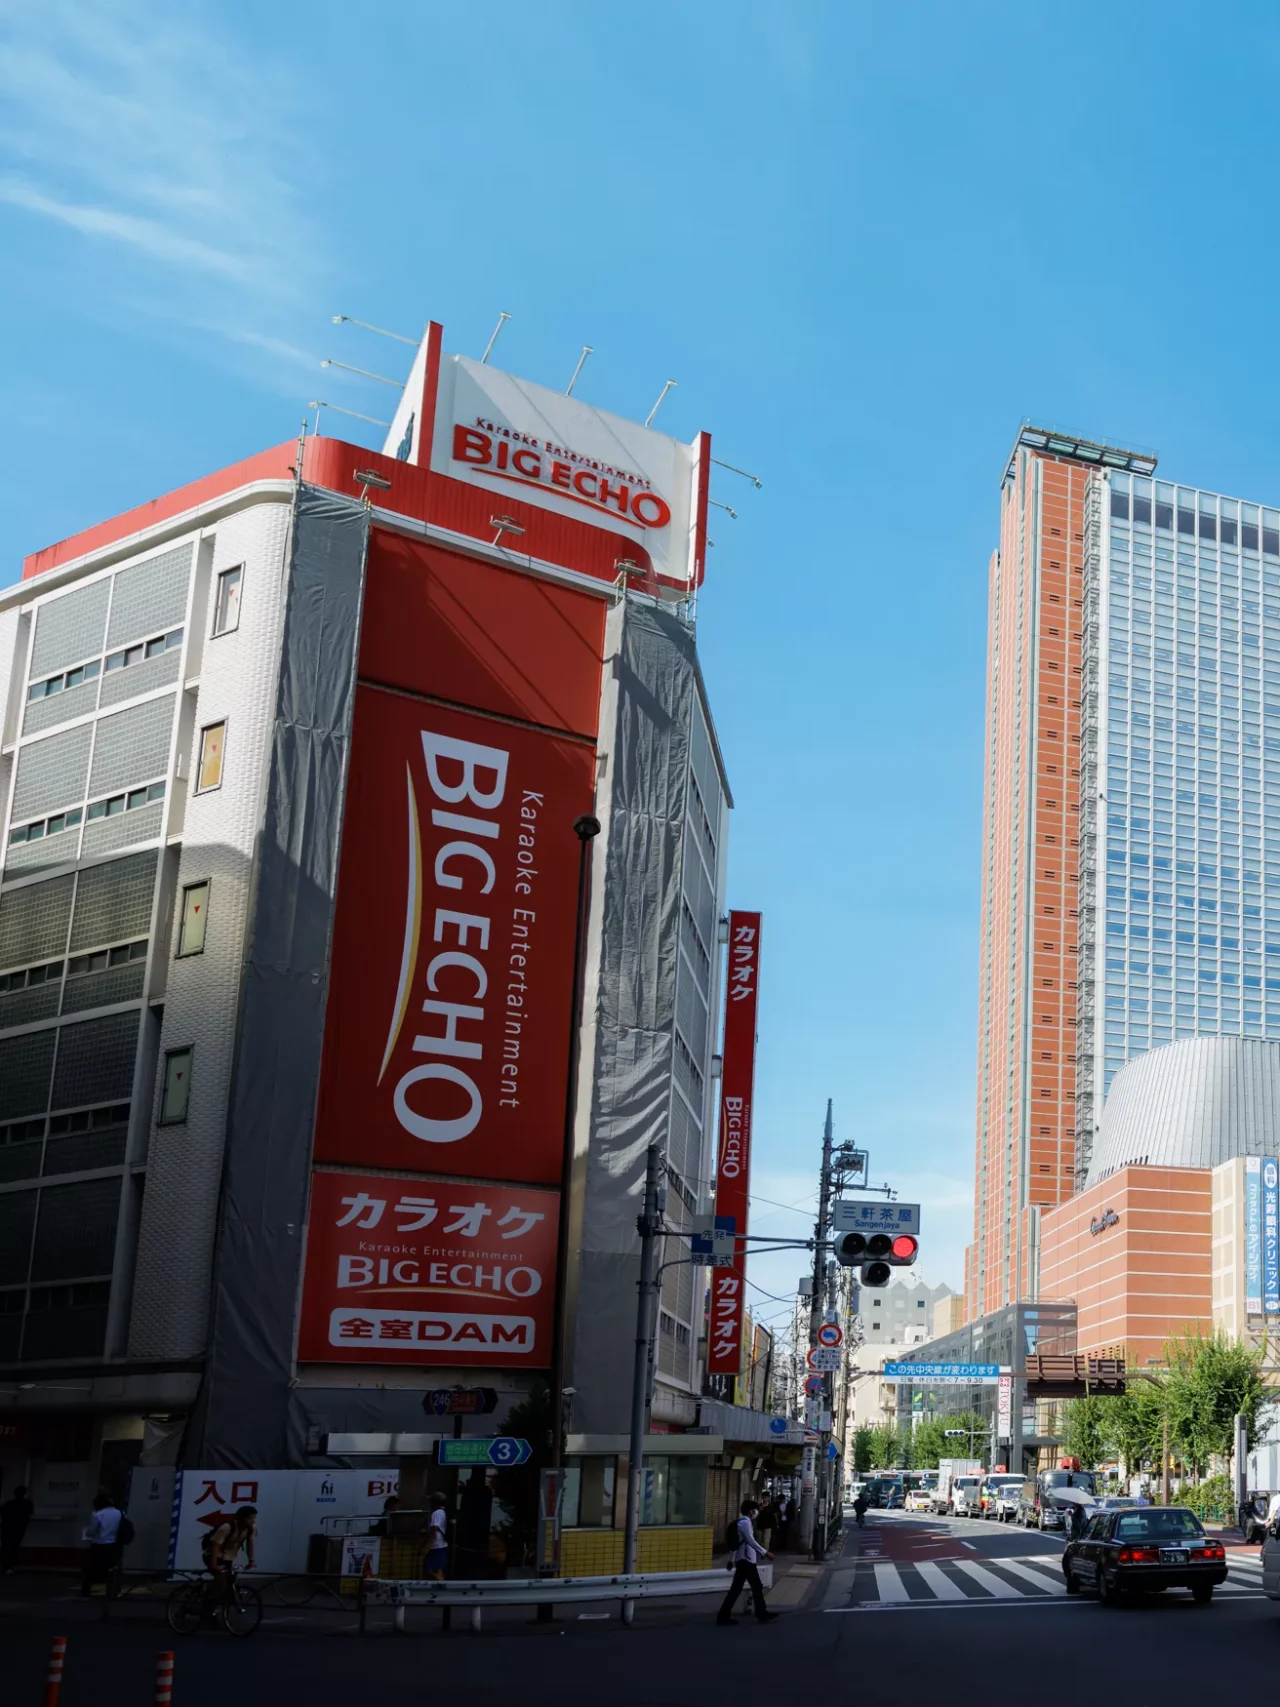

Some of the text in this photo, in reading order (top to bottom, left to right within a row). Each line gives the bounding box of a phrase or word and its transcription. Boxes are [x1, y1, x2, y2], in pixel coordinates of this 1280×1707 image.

[476, 417, 652, 489] Karaoke Entertainment
[453, 424, 671, 528] BIG ECHO
[394, 730, 510, 1143] BIG ECHO
[499, 790, 544, 1108] Karaoke Entertainment
[731, 926, 756, 1001] カラオケ
[722, 1096, 743, 1177] BIG ECHO
[335, 1193, 545, 1239] カラオケ
[842, 1206, 912, 1222] 三軒茶屋
[855, 1219, 900, 1230] Sangenjaya
[359, 1241, 524, 1262] Karaoke Entertainment
[702, 1230, 726, 1240] 先発
[337, 1254, 542, 1297] BIG ECHO
[691, 1254, 732, 1266] 時差式
[339, 1317, 528, 1345] 全室DAM
[713, 1277, 739, 1358] カラオケ
[889, 1365, 995, 1375] この先中央線が変わります
[497, 1442, 511, 1460] 3
[194, 1480, 259, 1505] 入口
